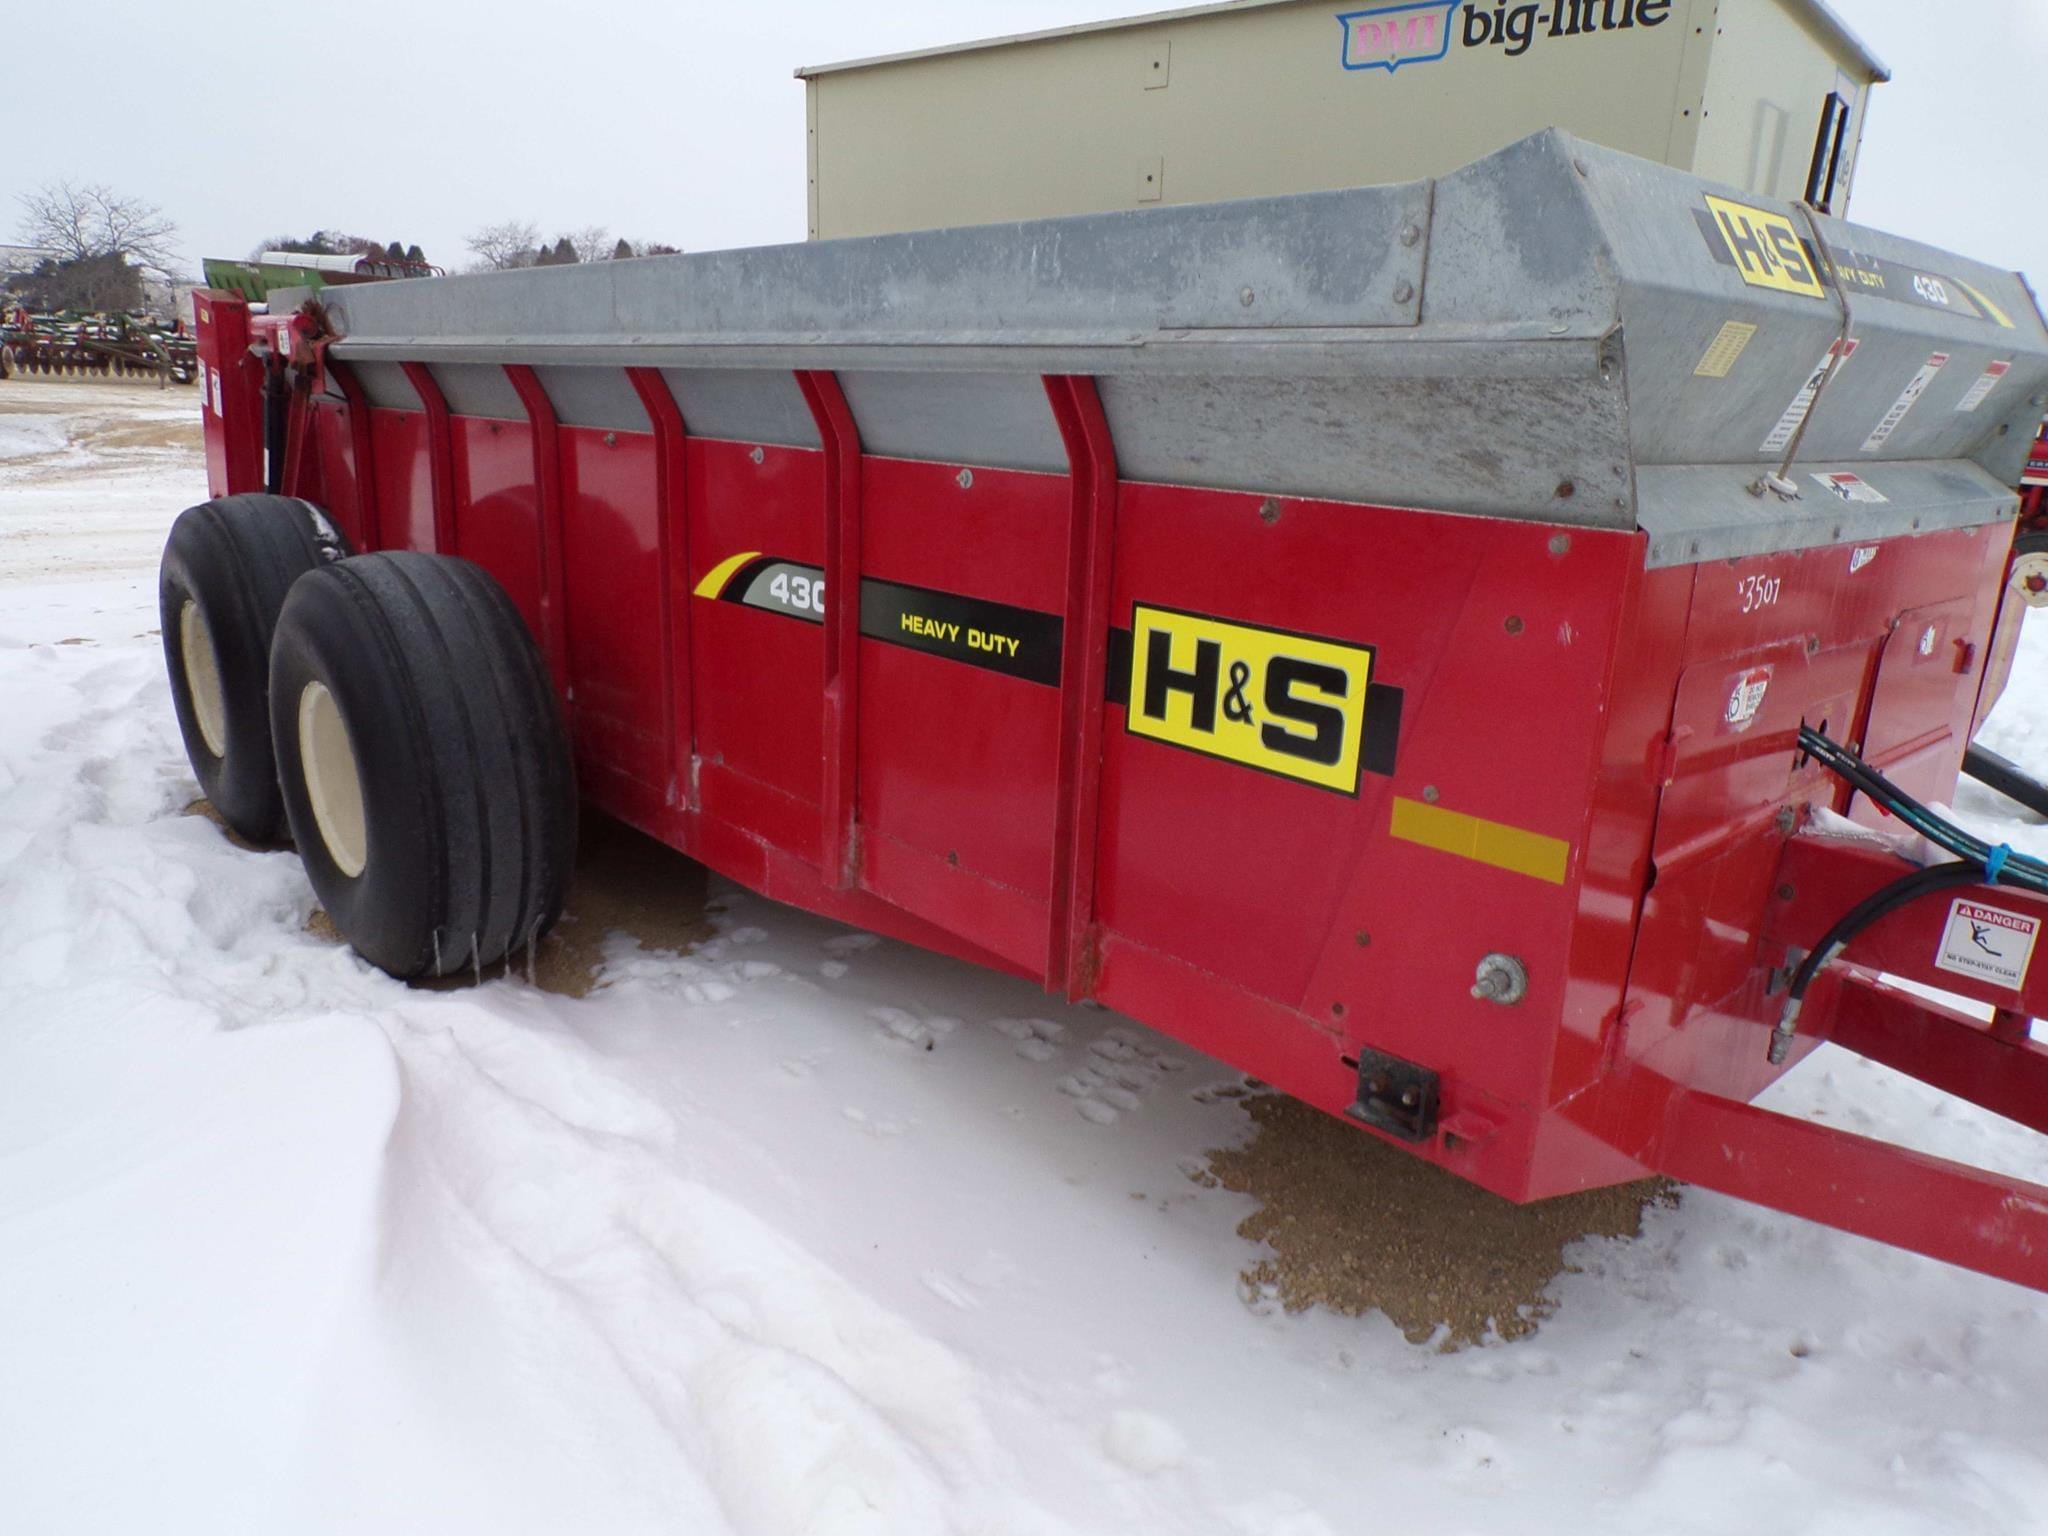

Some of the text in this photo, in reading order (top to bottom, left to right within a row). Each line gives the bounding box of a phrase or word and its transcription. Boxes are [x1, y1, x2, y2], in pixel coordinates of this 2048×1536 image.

[1356, 14, 1440, 56] DMI
[1461, 0, 1672, 56] big-little
[1716, 209, 1814, 286] H&S
[1913, 273, 1949, 305] 430
[901, 612, 960, 643] HEAVY
[967, 629, 1020, 658] DUTY
[1143, 627, 1350, 767] H&S
[1973, 908, 2032, 933] DANGER
